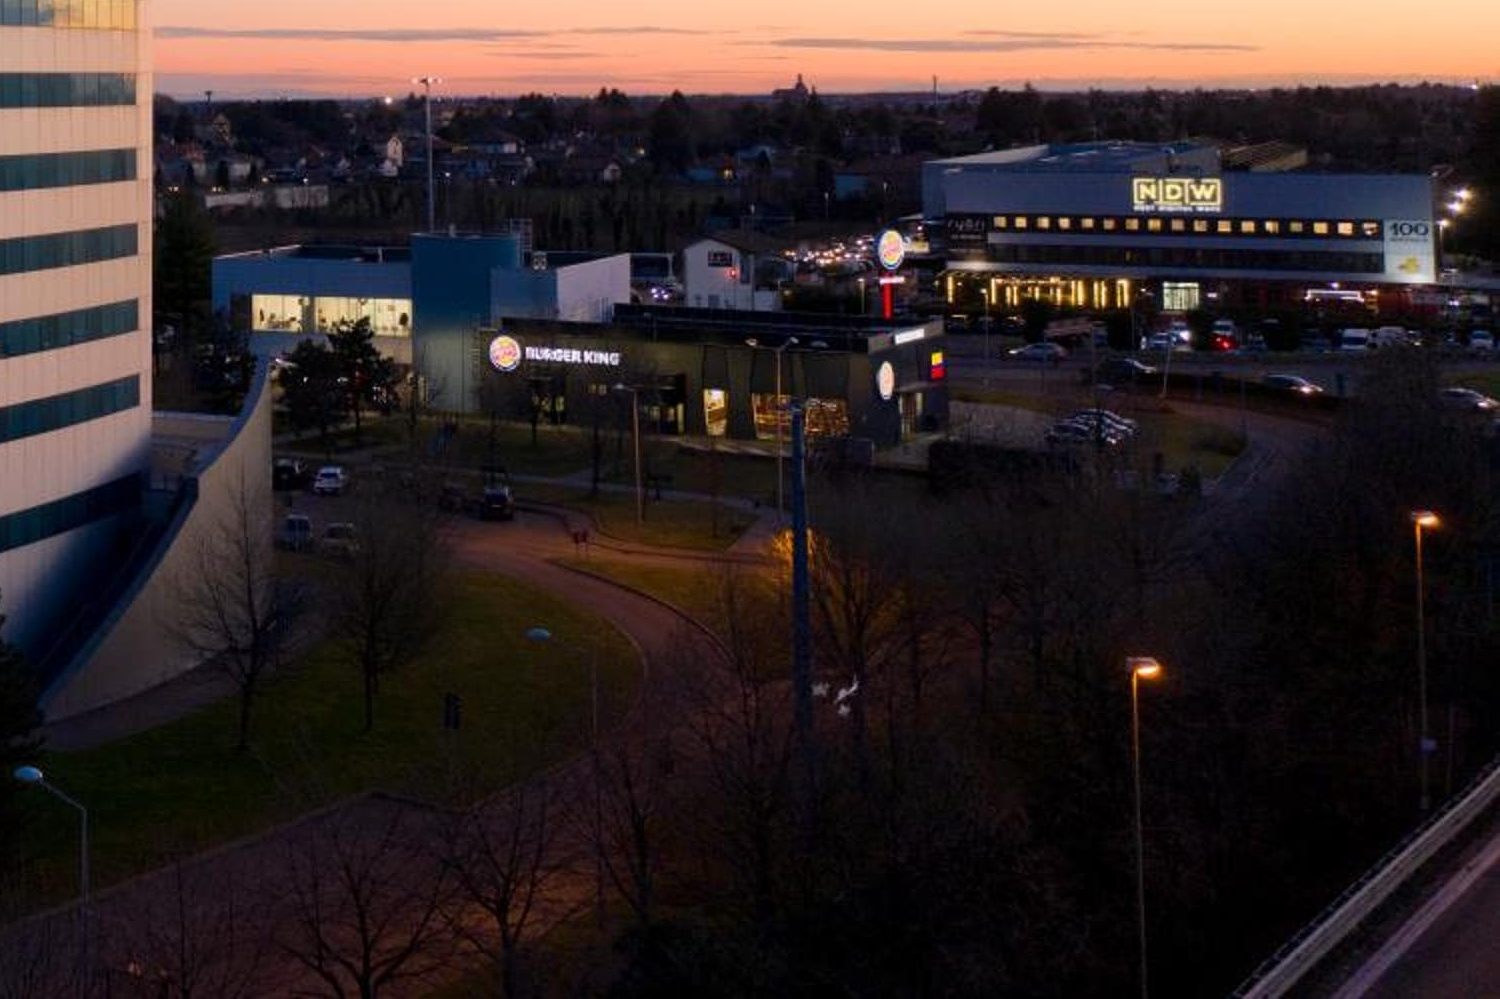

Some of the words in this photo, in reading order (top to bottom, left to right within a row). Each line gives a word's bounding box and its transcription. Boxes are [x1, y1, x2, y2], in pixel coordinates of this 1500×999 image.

[1138, 183, 1216, 201] NDW
[525, 346, 581, 363] BURGER
[583, 350, 620, 366] KING
